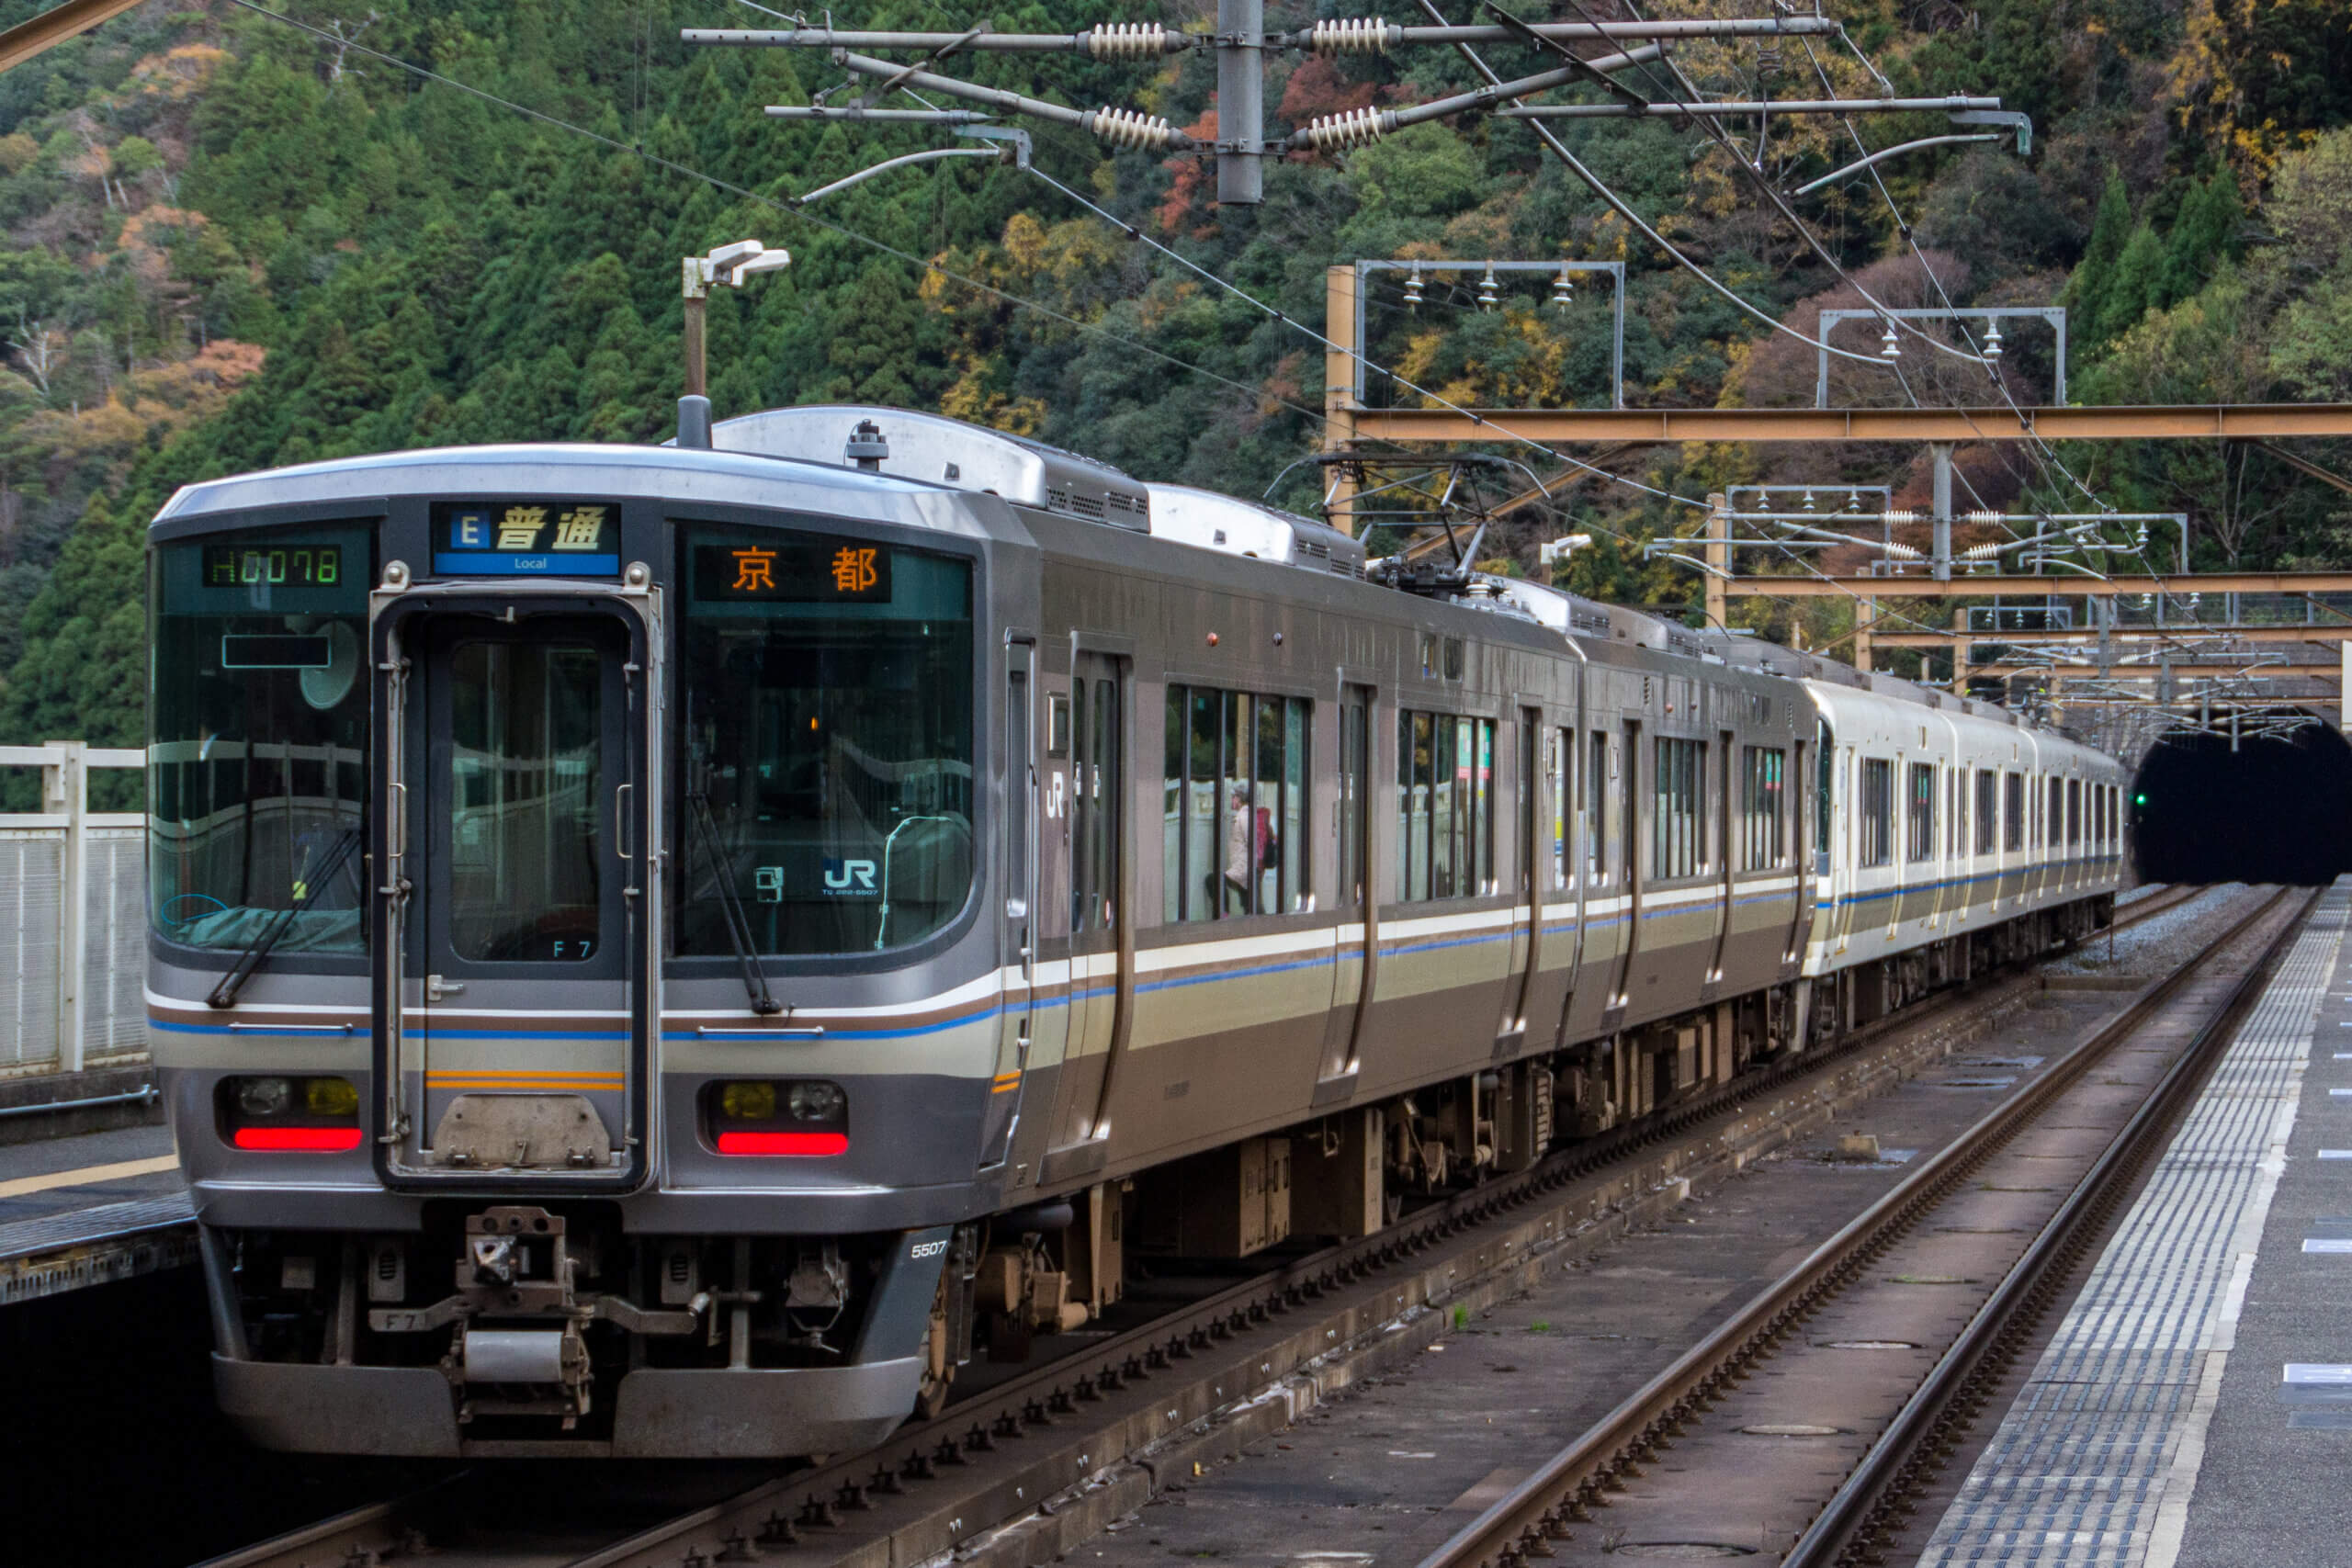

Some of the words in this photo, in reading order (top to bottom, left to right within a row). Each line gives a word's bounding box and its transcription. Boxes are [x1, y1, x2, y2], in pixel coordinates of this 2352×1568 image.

[461, 516, 479, 544] E
[496, 506, 608, 550] 普通
[514, 558, 547, 570] Local
[731, 546, 876, 592] 京都
[1046, 771, 1064, 819] JR
[825, 859, 876, 888] JR
[911, 1240, 947, 1258] 5507
